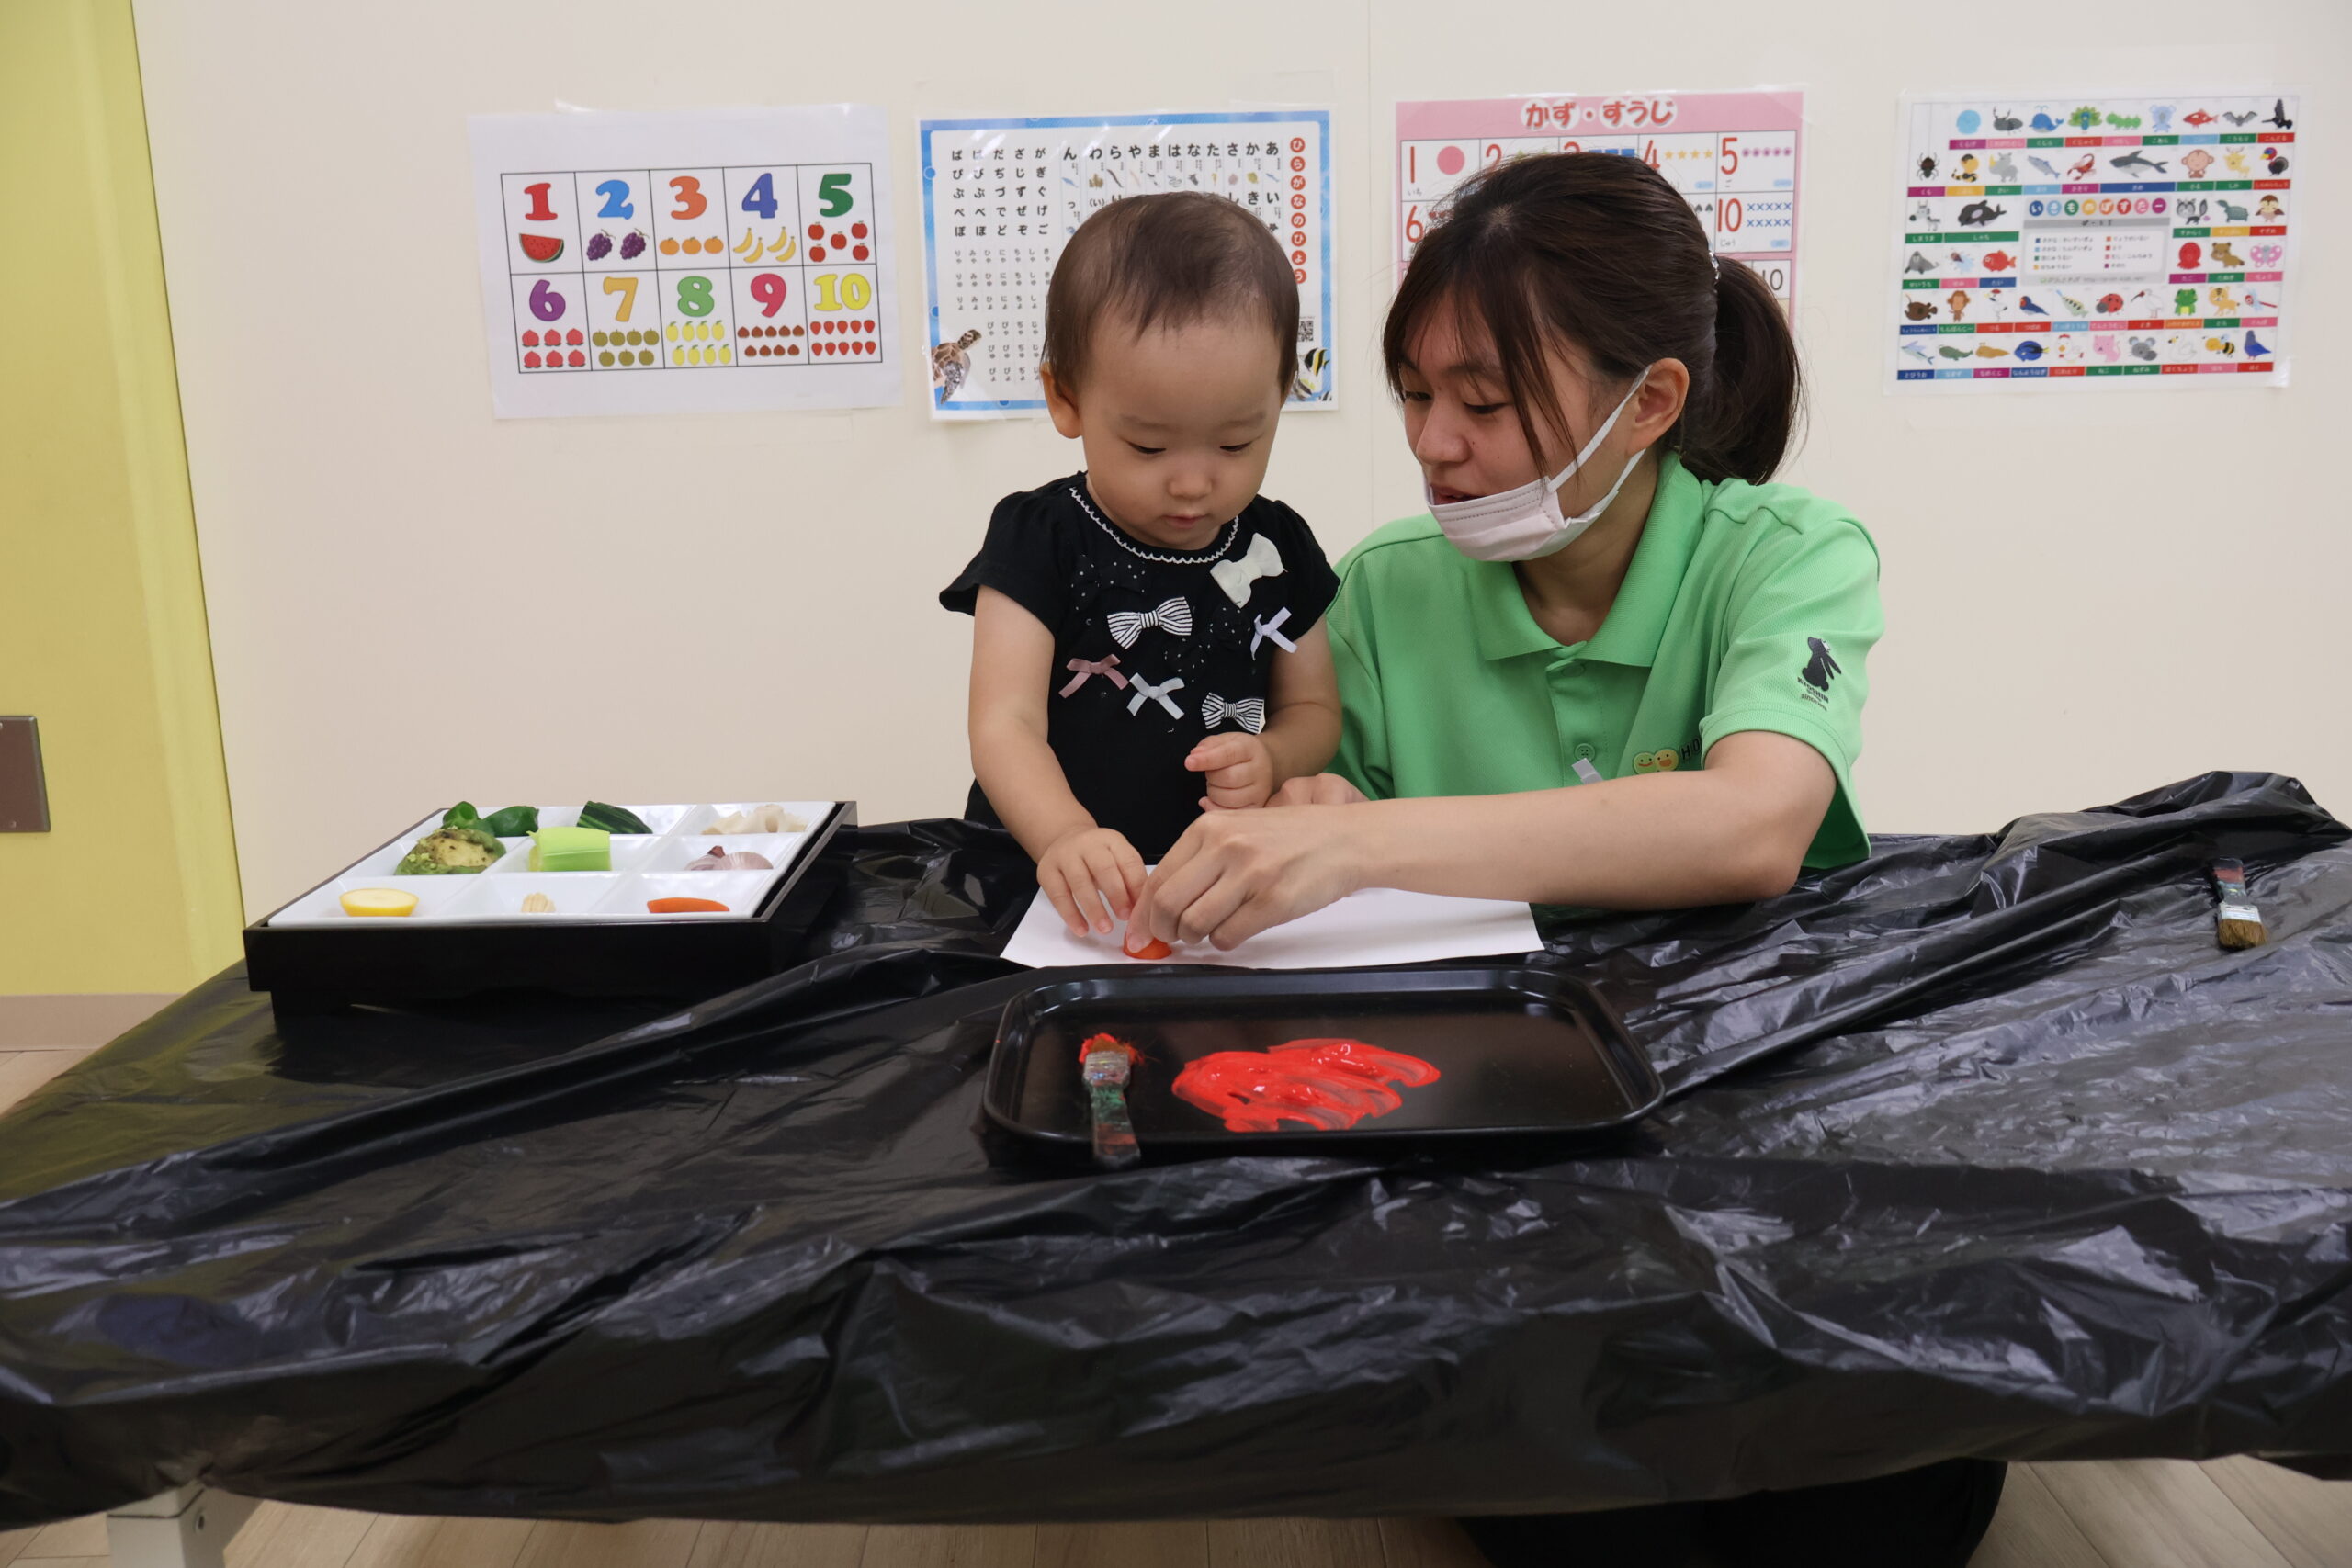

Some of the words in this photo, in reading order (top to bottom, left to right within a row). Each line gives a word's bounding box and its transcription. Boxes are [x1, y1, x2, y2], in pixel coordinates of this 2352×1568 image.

[1526, 100, 1673, 127] かず・すうじ
[1643, 139, 1661, 170] 4
[1721, 137, 1738, 175] 5
[525, 183, 558, 220] 1
[595, 180, 633, 220] 2
[669, 176, 707, 220] 3
[742, 174, 778, 219] 4
[820, 174, 853, 217] 5
[1291, 138, 1306, 283] ひらがなのひょう
[1406, 205, 1424, 243] 6
[1717, 197, 1743, 232] 10
[529, 279, 566, 321] 6
[603, 276, 639, 321] 7
[677, 276, 714, 316] 8
[751, 273, 786, 318] 9
[814, 273, 871, 311] 10
